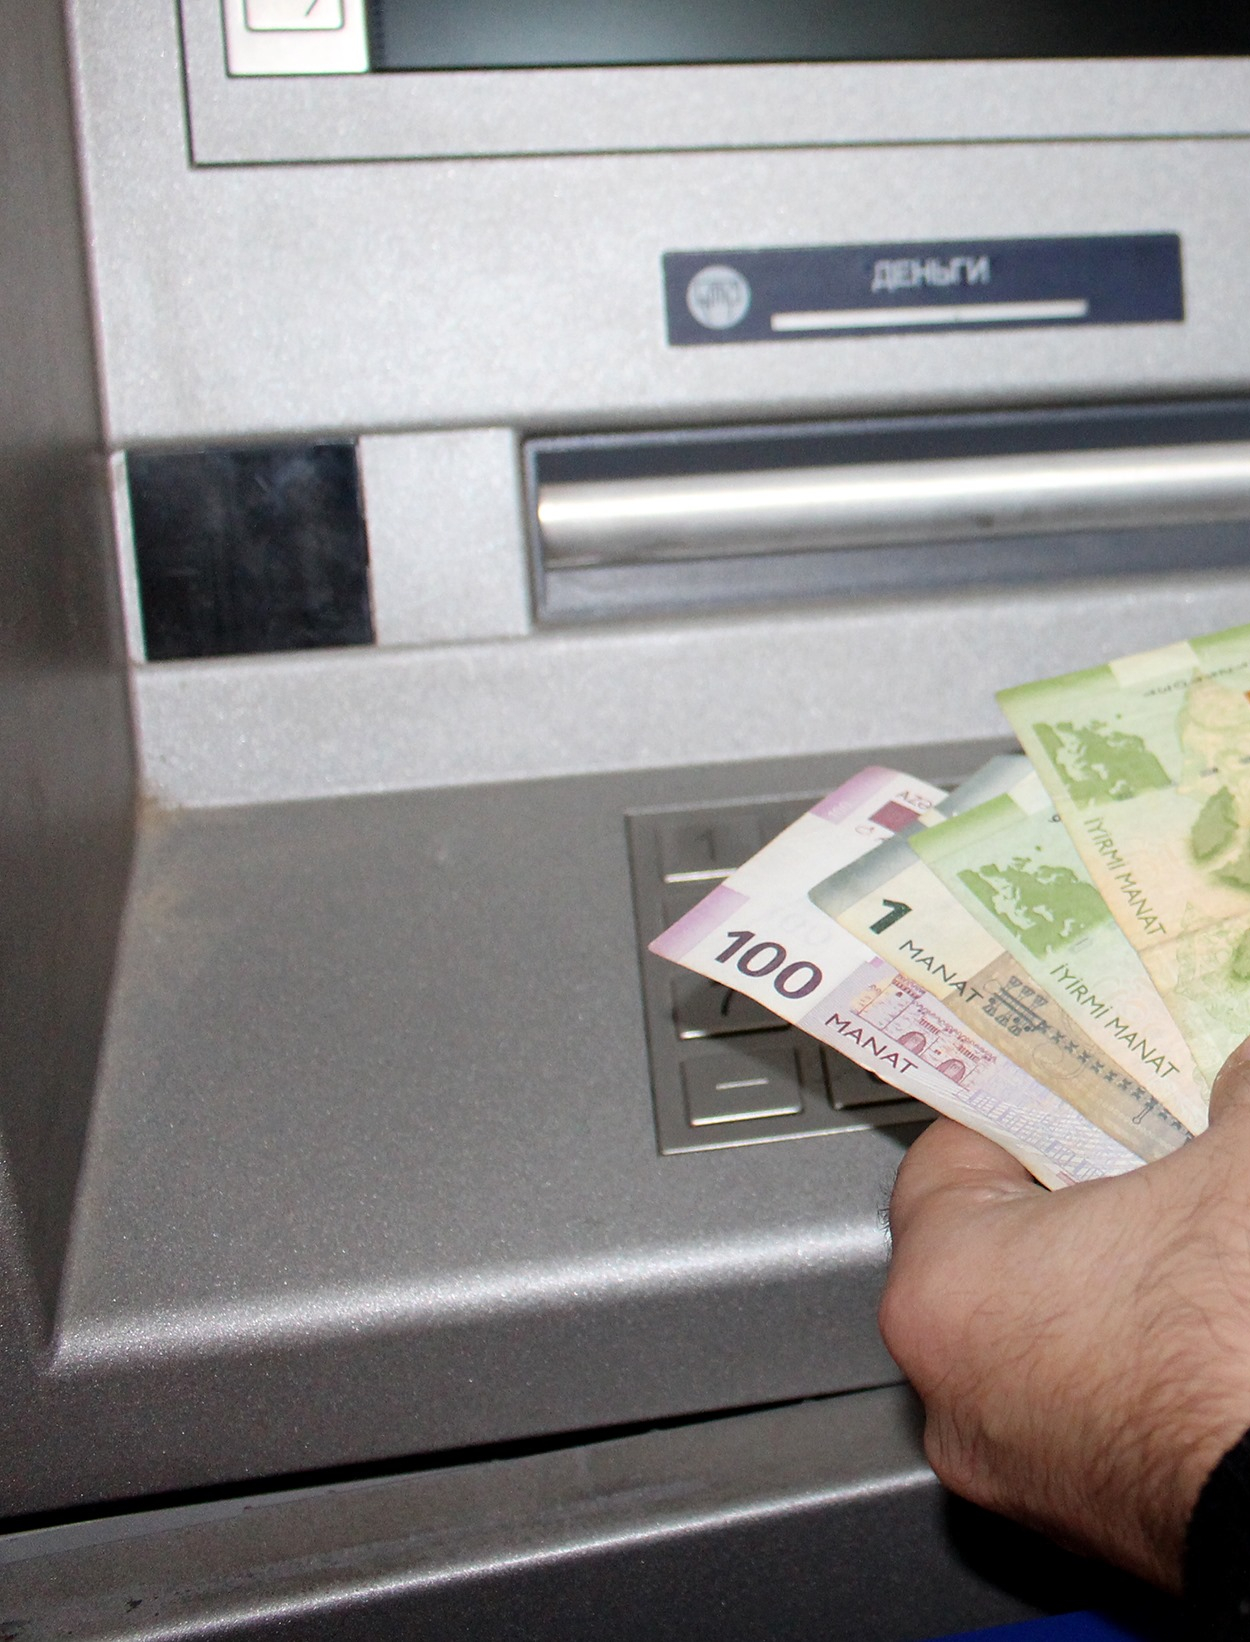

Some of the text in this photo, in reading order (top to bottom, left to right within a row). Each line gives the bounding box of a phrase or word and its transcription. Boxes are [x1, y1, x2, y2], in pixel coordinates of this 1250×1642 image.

[871, 255, 990, 293] ДЕНЬГИ
[869, 899, 912, 935] 1
[1114, 872, 1167, 935] MANAT
[714, 930, 823, 999] 100
[899, 939, 984, 1003] MANAT
[825, 1013, 919, 1074] MANAT
[1104, 1016, 1180, 1078] MANAT
